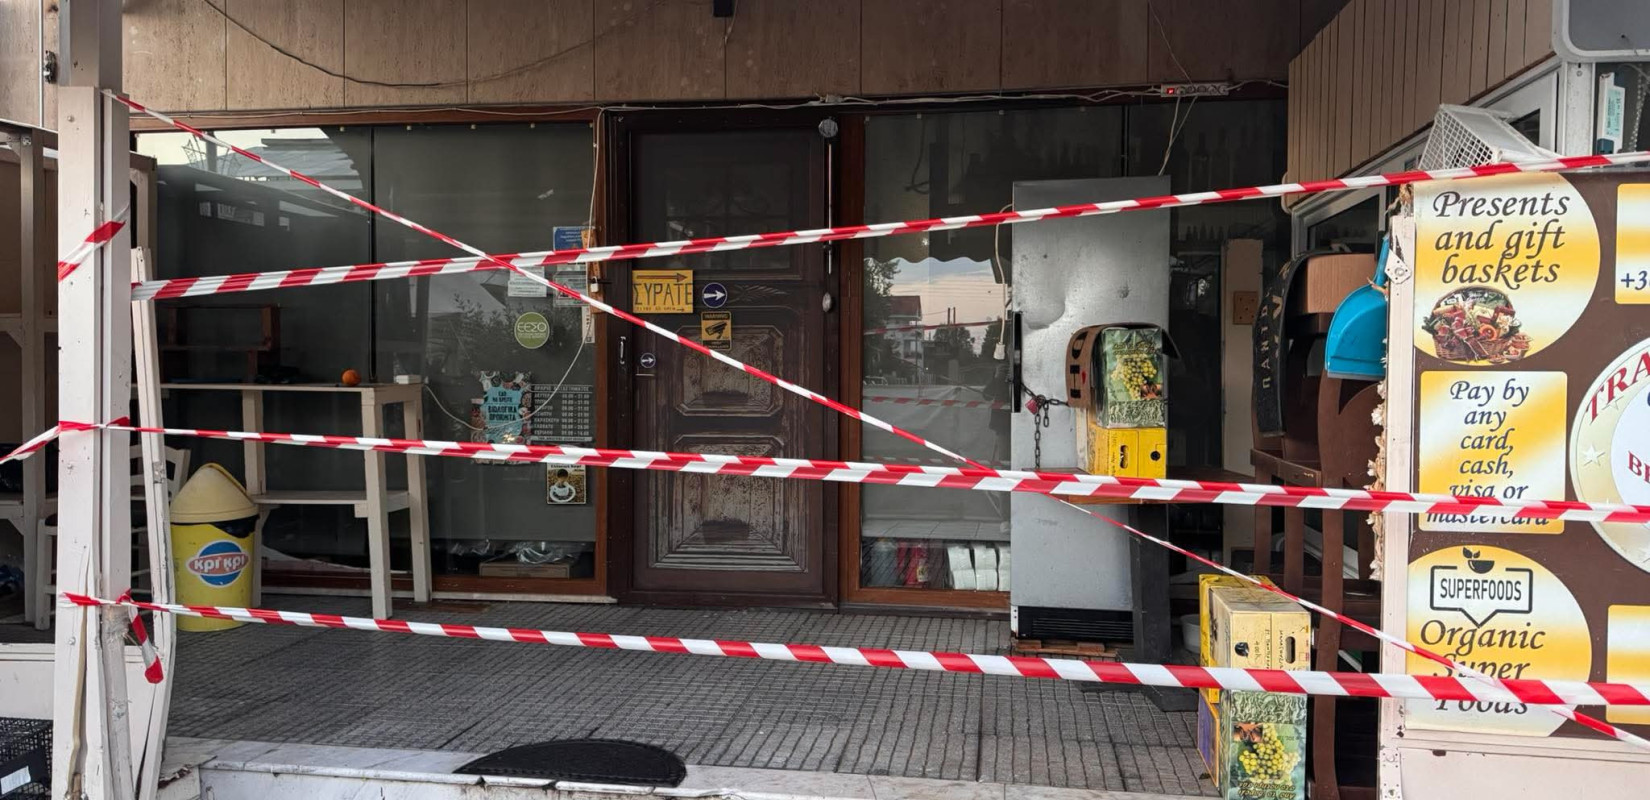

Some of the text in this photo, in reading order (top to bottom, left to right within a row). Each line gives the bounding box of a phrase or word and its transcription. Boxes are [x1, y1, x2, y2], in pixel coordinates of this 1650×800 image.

[1433, 191, 1570, 217] Presents
[1434, 218, 1566, 260] and gift
[1442, 250, 1561, 290] baskets
[1620, 270, 1650, 291] +3
[632, 283, 693, 306] ΣΥΡΑΤΕ
[1450, 378, 1530, 407] Pay by
[1464, 410, 1506, 432] any
[1460, 428, 1515, 454] card,
[1459, 453, 1514, 478] cash,
[1450, 479, 1529, 499] visa or
[1440, 578, 1522, 601] SUPERFOODS
[1420, 619, 1547, 656] Organic
